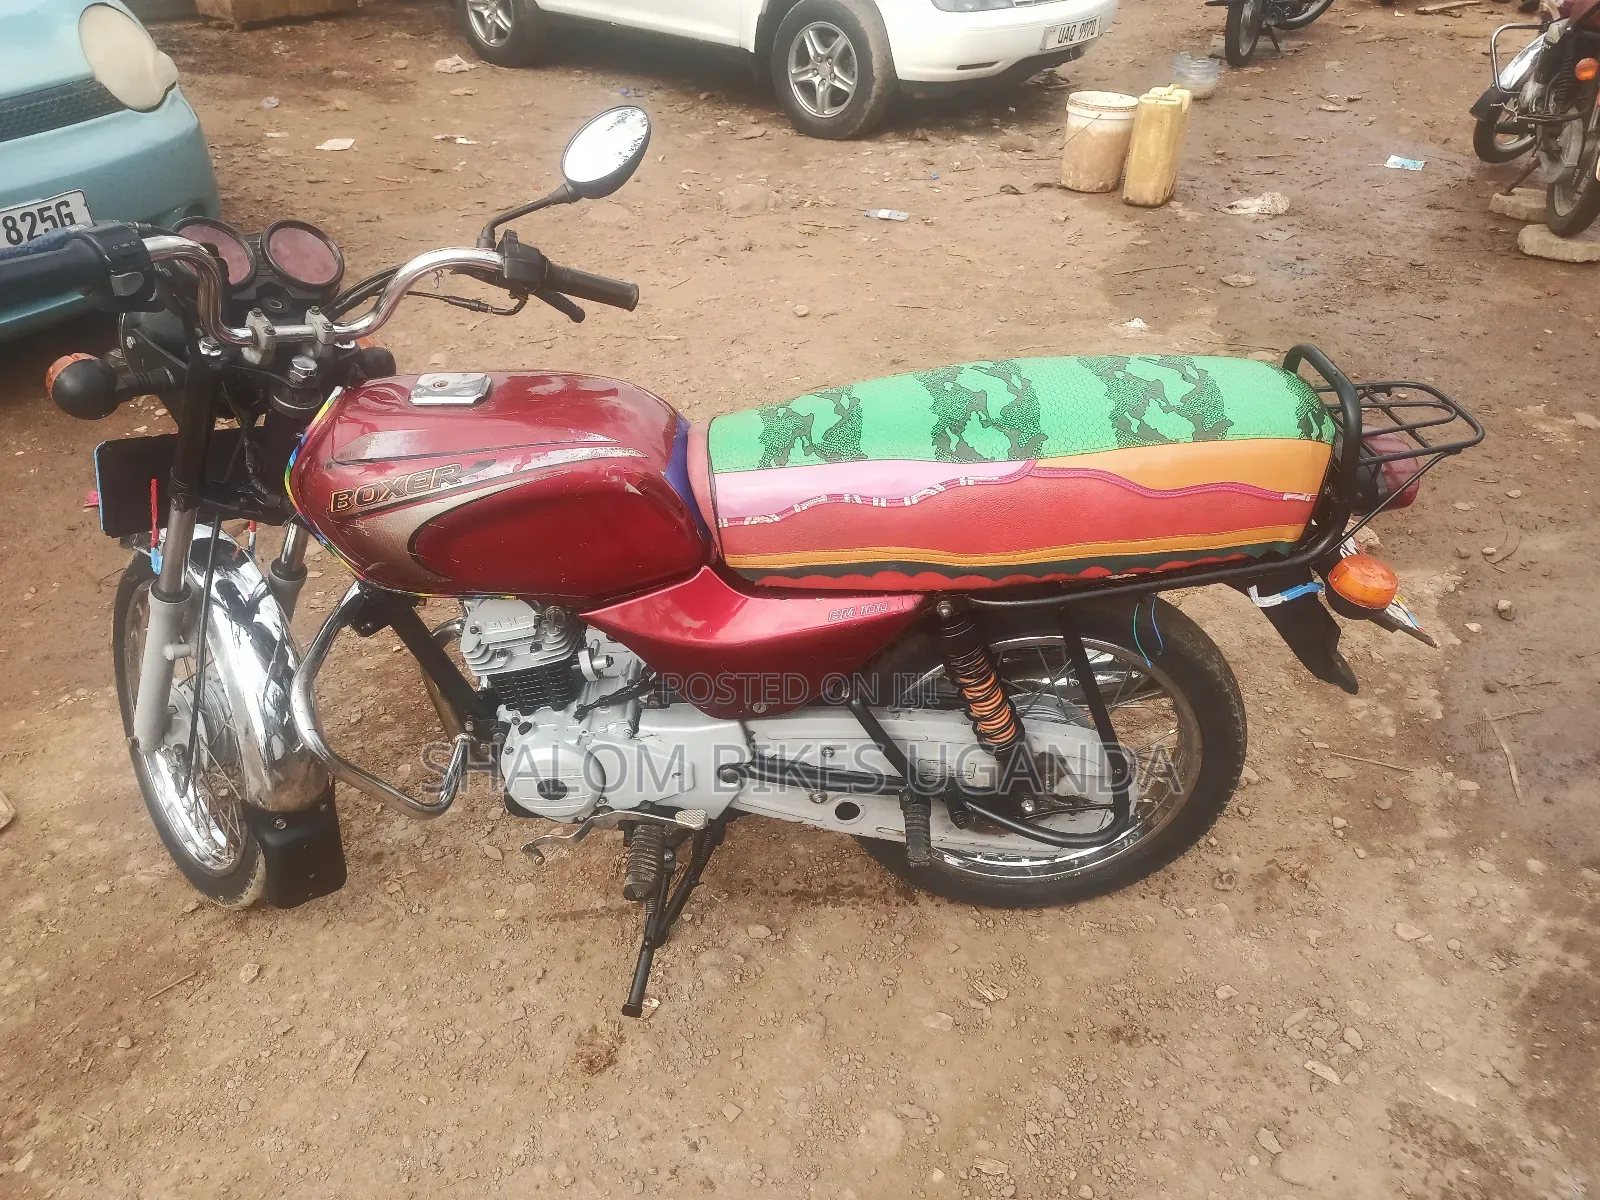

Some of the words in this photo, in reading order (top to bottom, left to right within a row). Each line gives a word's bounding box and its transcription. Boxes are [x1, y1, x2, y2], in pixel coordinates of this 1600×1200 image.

[2, 200, 77, 246] 825G
[330, 463, 463, 513] BOXER
[828, 606, 857, 622] BM
[860, 602, 890, 616] 100
